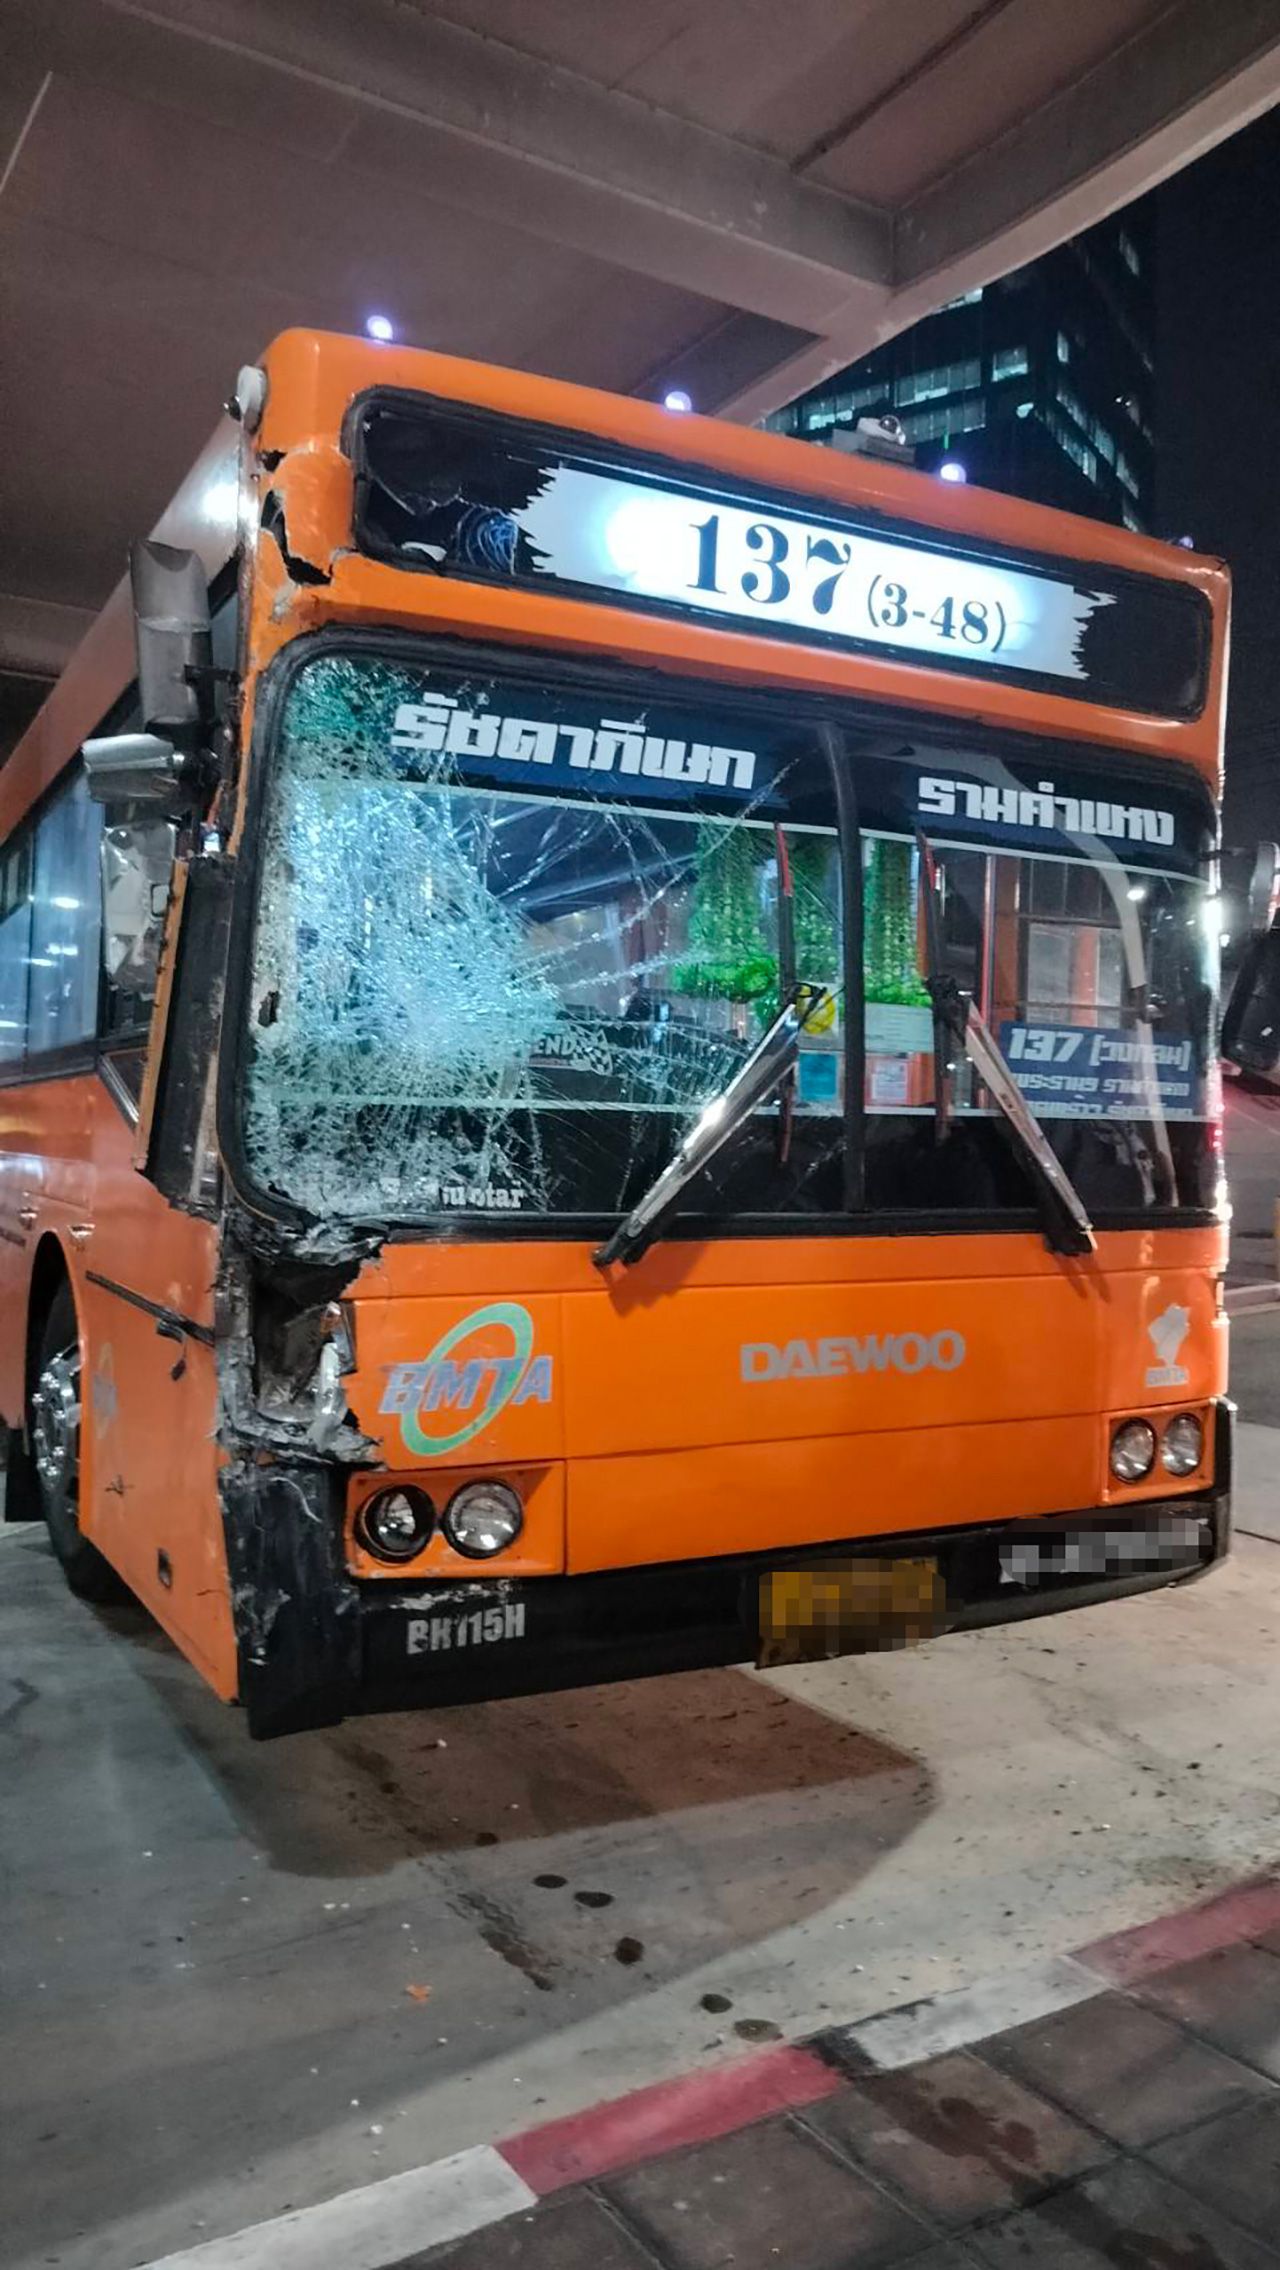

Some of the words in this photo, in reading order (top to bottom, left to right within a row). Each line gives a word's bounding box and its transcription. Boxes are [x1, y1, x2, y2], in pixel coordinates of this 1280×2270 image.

[686, 514, 853, 616] 137
[867, 574, 1007, 653] (3-48)
[391, 692, 756, 790] รัชดาภิเษก
[918, 776, 1175, 846] รามคำแหง
[1009, 1028, 1084, 1063] 137
[378, 1355, 554, 1415] BMTA
[740, 1329, 966, 1383] DAEWOO
